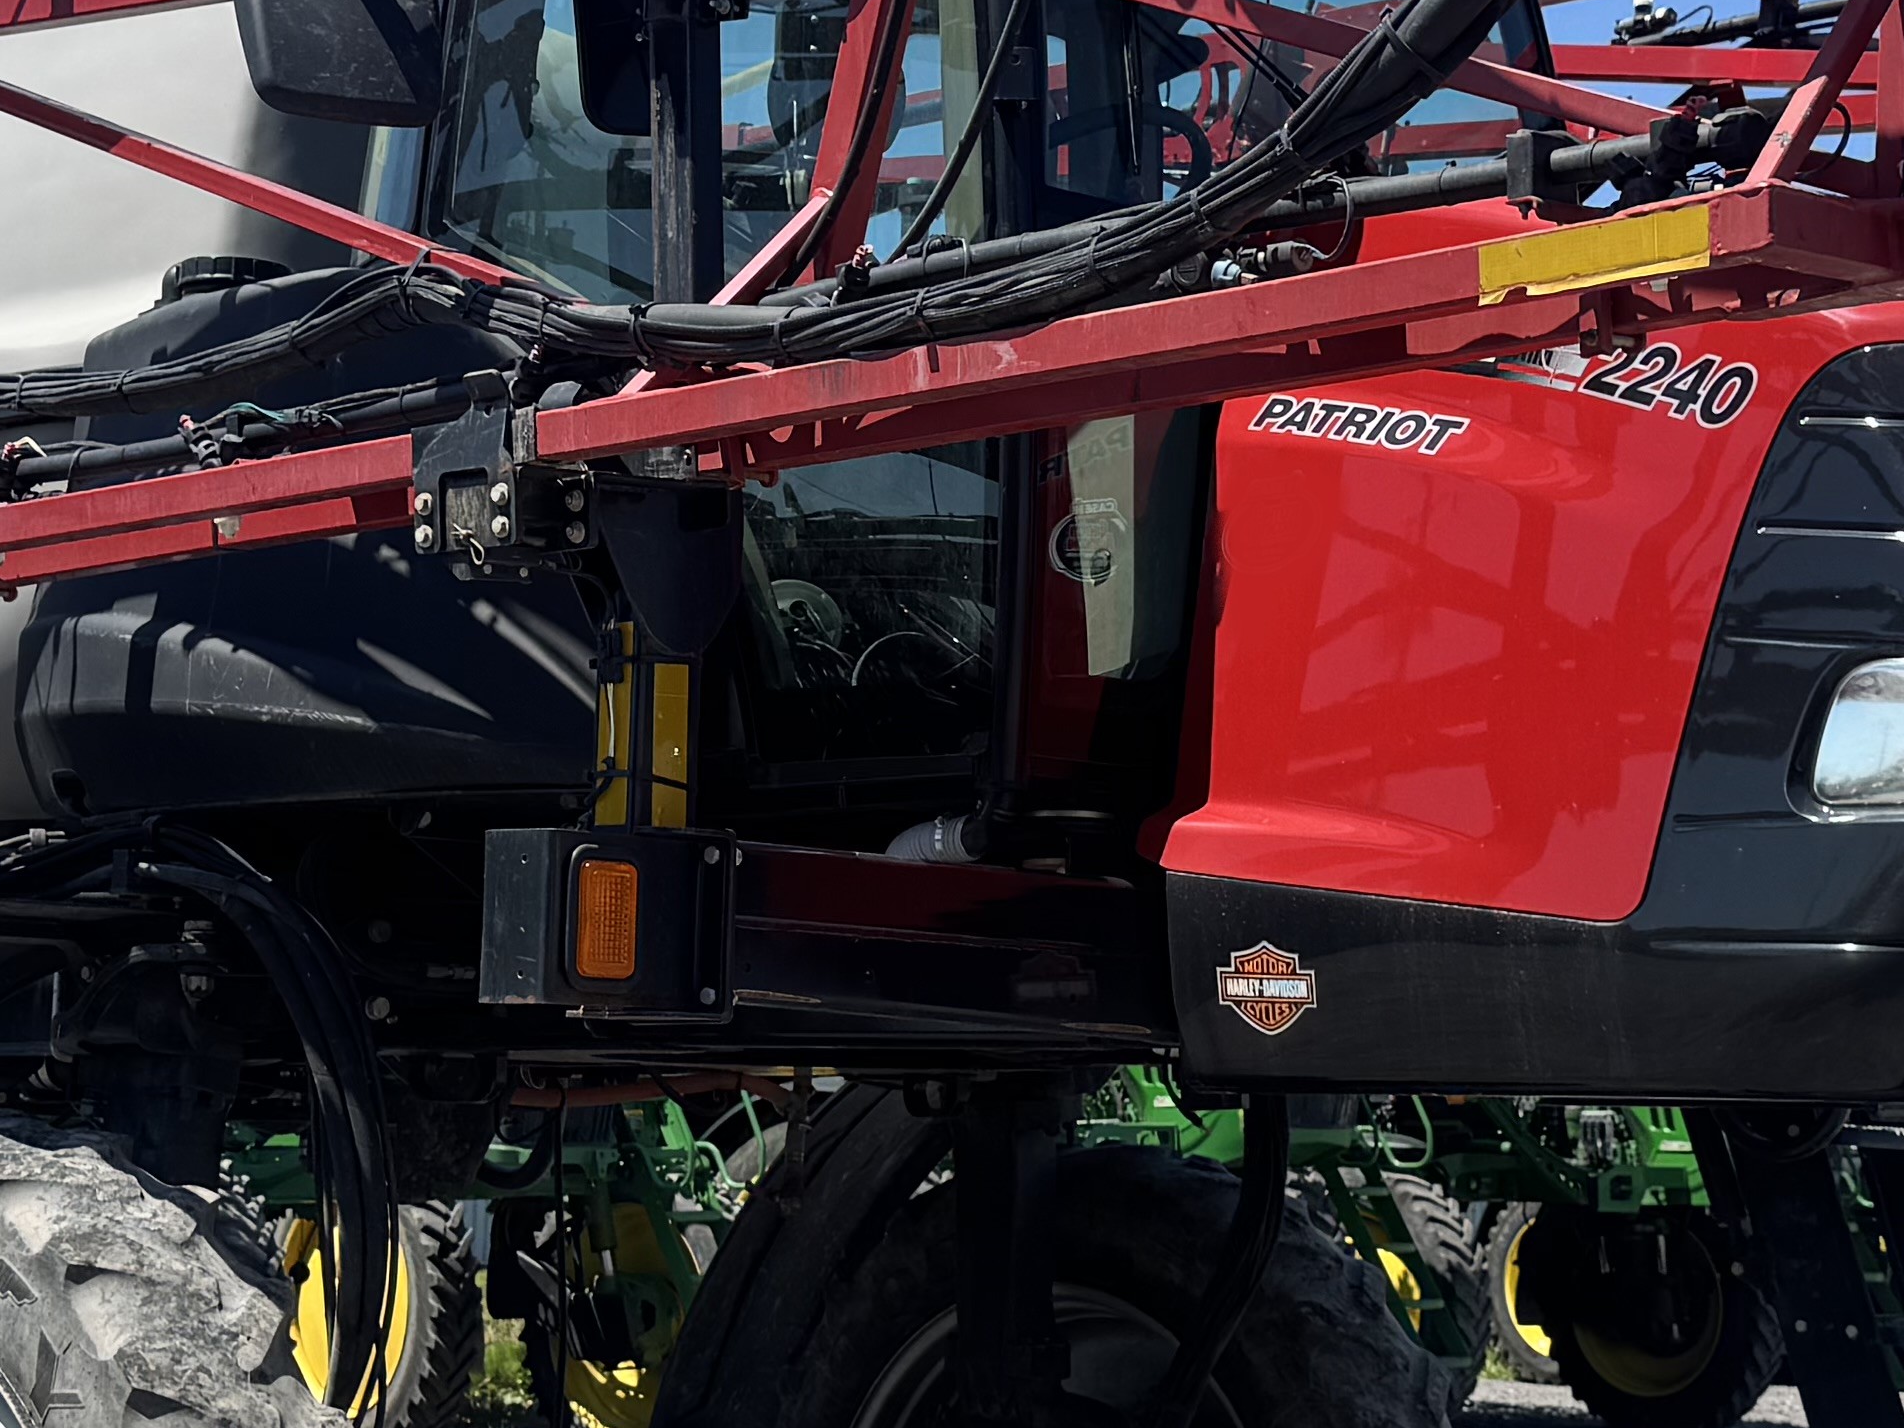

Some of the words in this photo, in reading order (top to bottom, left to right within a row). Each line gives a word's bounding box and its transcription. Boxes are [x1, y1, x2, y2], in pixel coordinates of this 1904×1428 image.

[1578, 342, 1758, 429] 2240
[1248, 393, 1470, 455] PATRIOT
[1244, 954, 1287, 974] MOTOR
[1226, 978, 1308, 998] HARLEY-DAVIDSON
[1246, 1002, 1290, 1025] CYCLES
